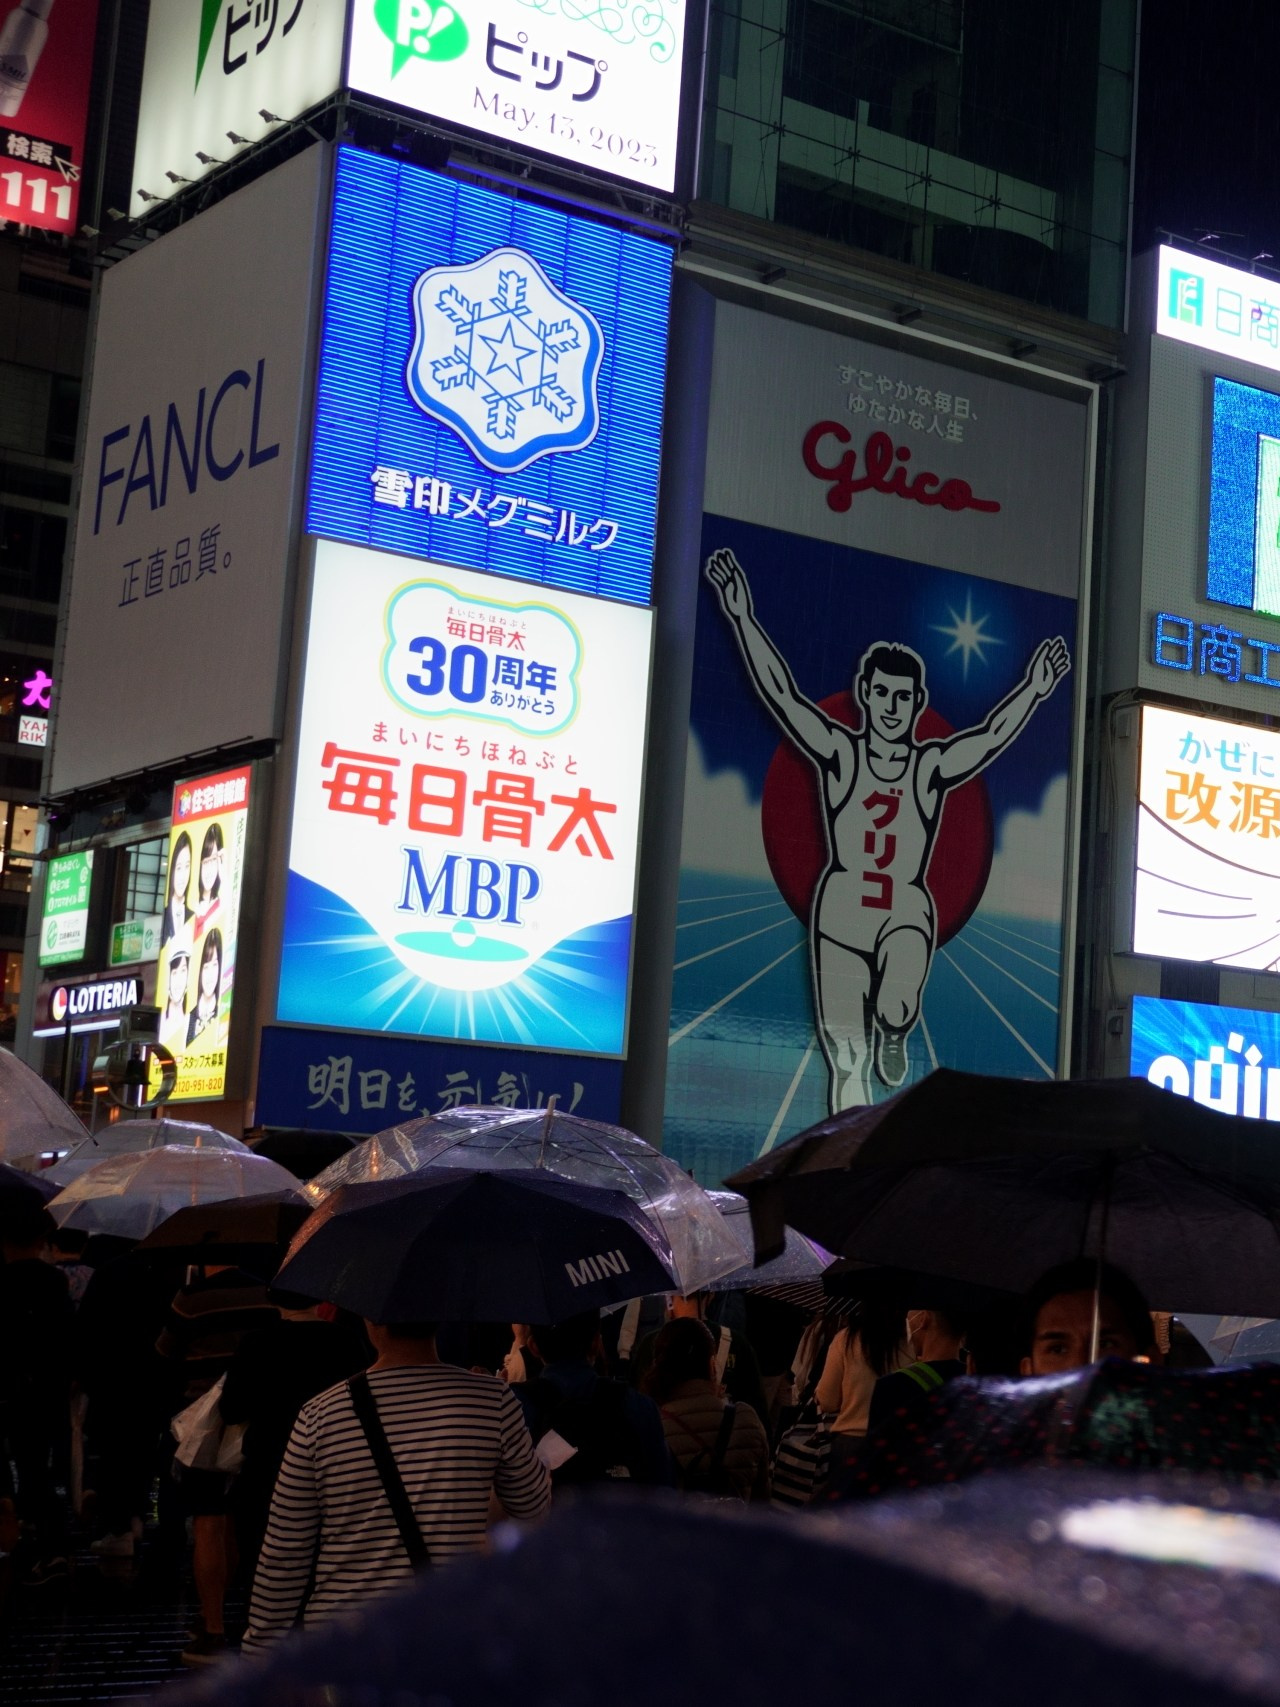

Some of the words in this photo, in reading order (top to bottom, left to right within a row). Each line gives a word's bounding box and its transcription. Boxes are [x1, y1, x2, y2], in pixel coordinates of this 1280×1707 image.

[223, 0, 304, 75] ピッ
[486, 22, 609, 102] ピップ
[7, 133, 53, 165] 検索
[1, 171, 72, 220] 111
[838, 365, 978, 421] すこやかな毎日、
[848, 393, 964, 443] ゆたかな人生
[93, 358, 280, 536] FANCL
[802, 420, 1001, 513] Glico
[370, 465, 619, 550] 雪印メグミルク
[118, 523, 232, 608] 正直品質。
[446, 616, 527, 652] 毎日骨太
[447, 606, 528, 630] まいにちほねぶと
[406, 635, 558, 704] 30周年
[490, 689, 556, 716] ありがとう
[372, 721, 579, 776] まいにちほねぶと
[1179, 730, 1275, 779] かぜに
[320, 741, 618, 861] 毎日骨太
[861, 787, 904, 911] グリコ
[397, 847, 541, 926] MBP
[68, 979, 138, 1015] LOTTERIA
[183, 1052, 225, 1070] スタッフ大募集
[564, 1249, 631, 1288] MINI
